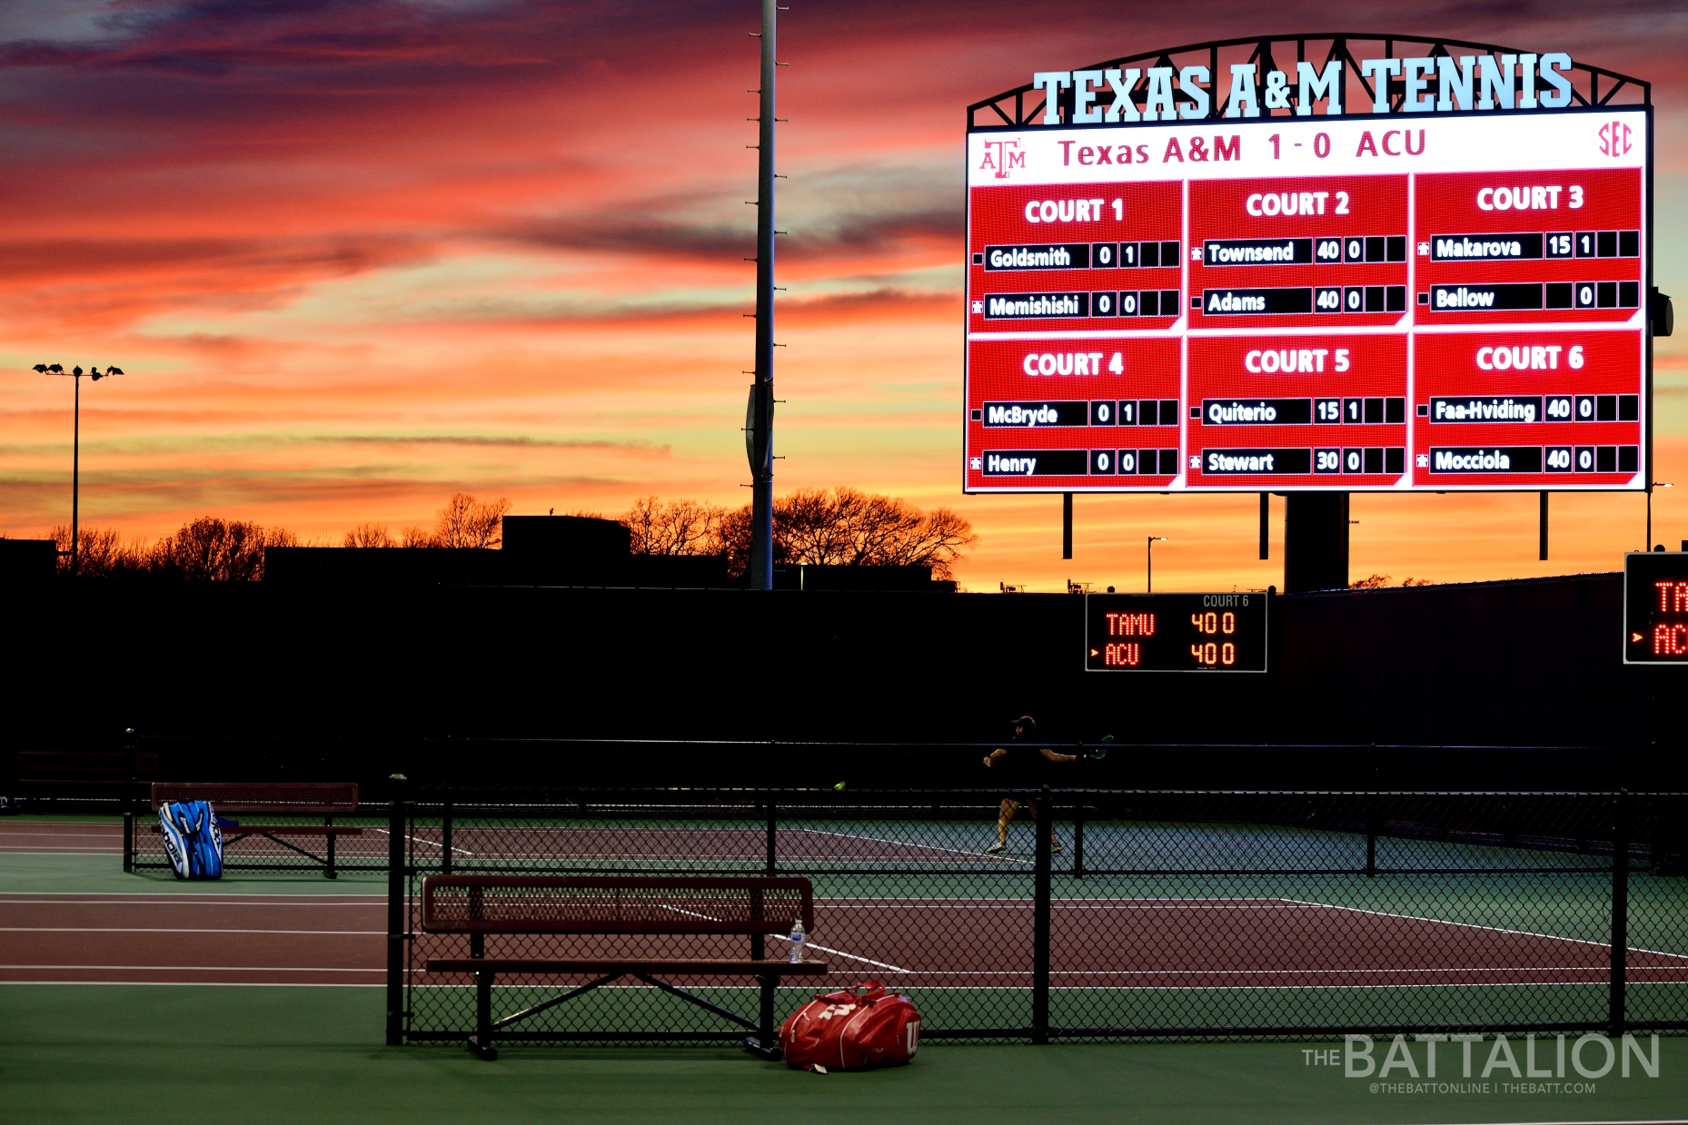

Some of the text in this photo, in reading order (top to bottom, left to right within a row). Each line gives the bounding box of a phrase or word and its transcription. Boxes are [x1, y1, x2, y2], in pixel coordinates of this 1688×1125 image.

[1034, 53, 1573, 125] TEXAS A&M TENNIS
[1058, 141, 1148, 166] Texas
[1163, 135, 1240, 163] A&M
[1269, 134, 1279, 159] 1
[1314, 133, 1330, 158] 0
[1356, 130, 1425, 157] ACU
[1599, 122, 1631, 157] SEC
[1247, 192, 1349, 216] COURT 2
[1477, 186, 1583, 210] COURT 3
[1025, 199, 1122, 223] COURT 1
[991, 246, 1133, 267] Goldsmith 0 1
[1209, 241, 1360, 262] Townsend 40 0
[1437, 236, 1589, 257] Makarova 15 1
[990, 296, 1135, 315] Memishishi 0 0
[1208, 291, 1359, 311] Adams 40 0
[1437, 287, 1592, 307] Bellow 0
[1024, 353, 1123, 375] COURT 4
[1246, 349, 1349, 372] COURT 5
[1477, 346, 1584, 370] COURT 6
[989, 404, 1131, 426] McBryde 0 1
[1209, 402, 1356, 424] Quiterio 15 1
[1436, 399, 1591, 422] Faa-Hviding 40 0
[989, 454, 1134, 474] Henry 0 0
[1209, 452, 1359, 470] Stewart 30 0
[1436, 450, 1591, 469] Mocciola 40 0
[1203, 594, 1249, 607] COURT 6
[1106, 612, 1234, 636] TAMU 40 0
[1105, 643, 1234, 666] ACU 40 0
